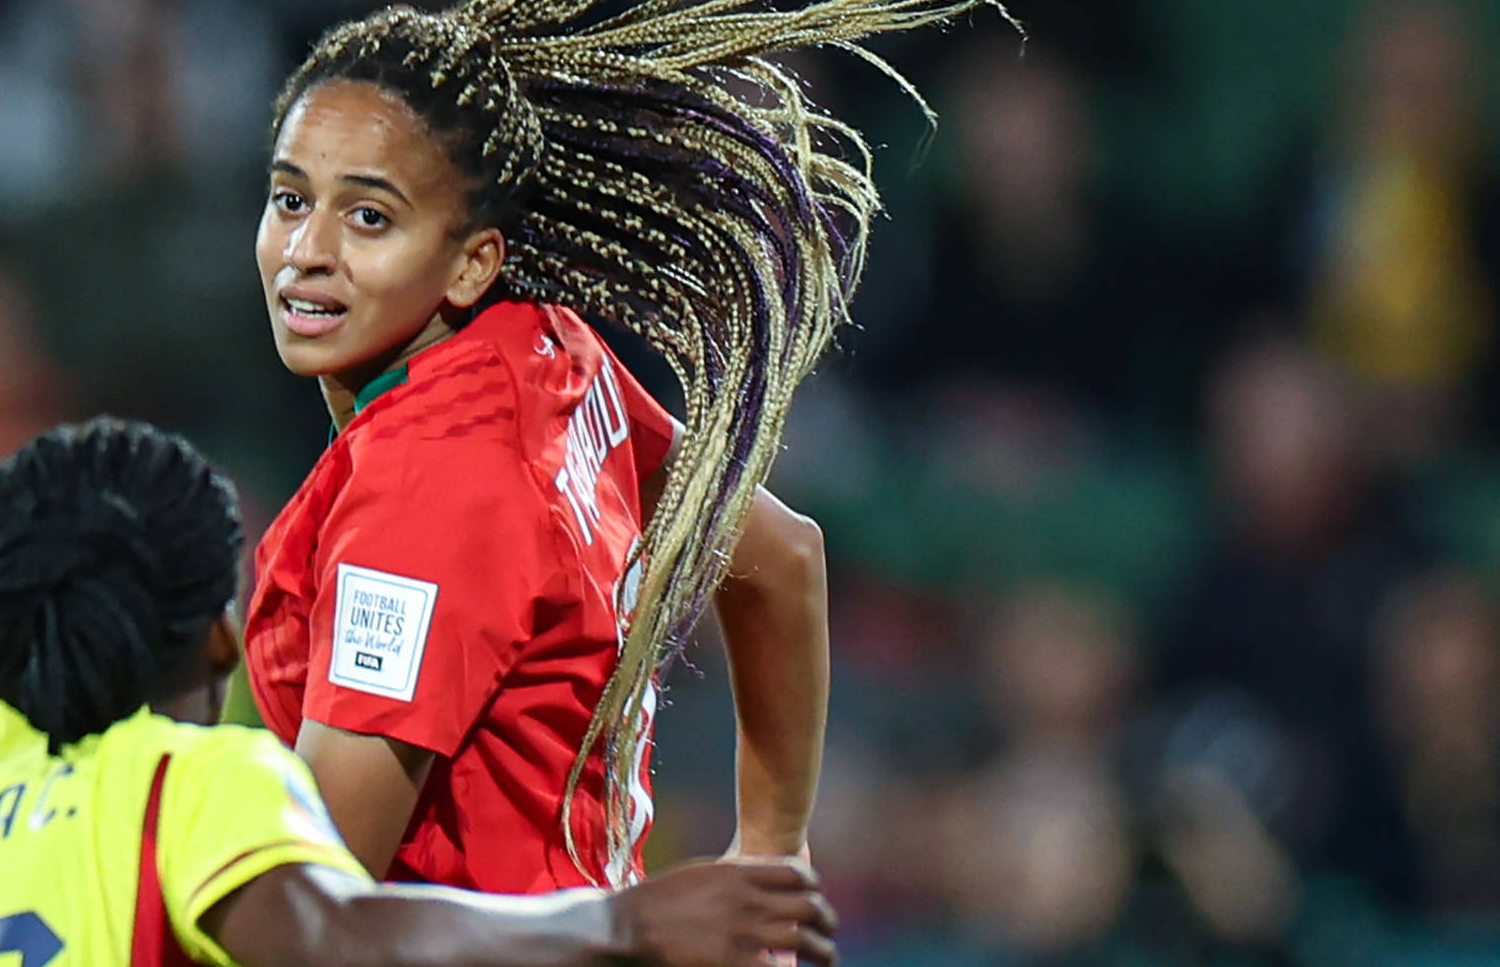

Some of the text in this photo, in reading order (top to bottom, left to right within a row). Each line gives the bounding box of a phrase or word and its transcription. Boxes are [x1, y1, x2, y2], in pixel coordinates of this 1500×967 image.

[353, 589, 406, 615] FOOTBALL
[351, 606, 404, 636] UNITES
[345, 628, 404, 655] the World
